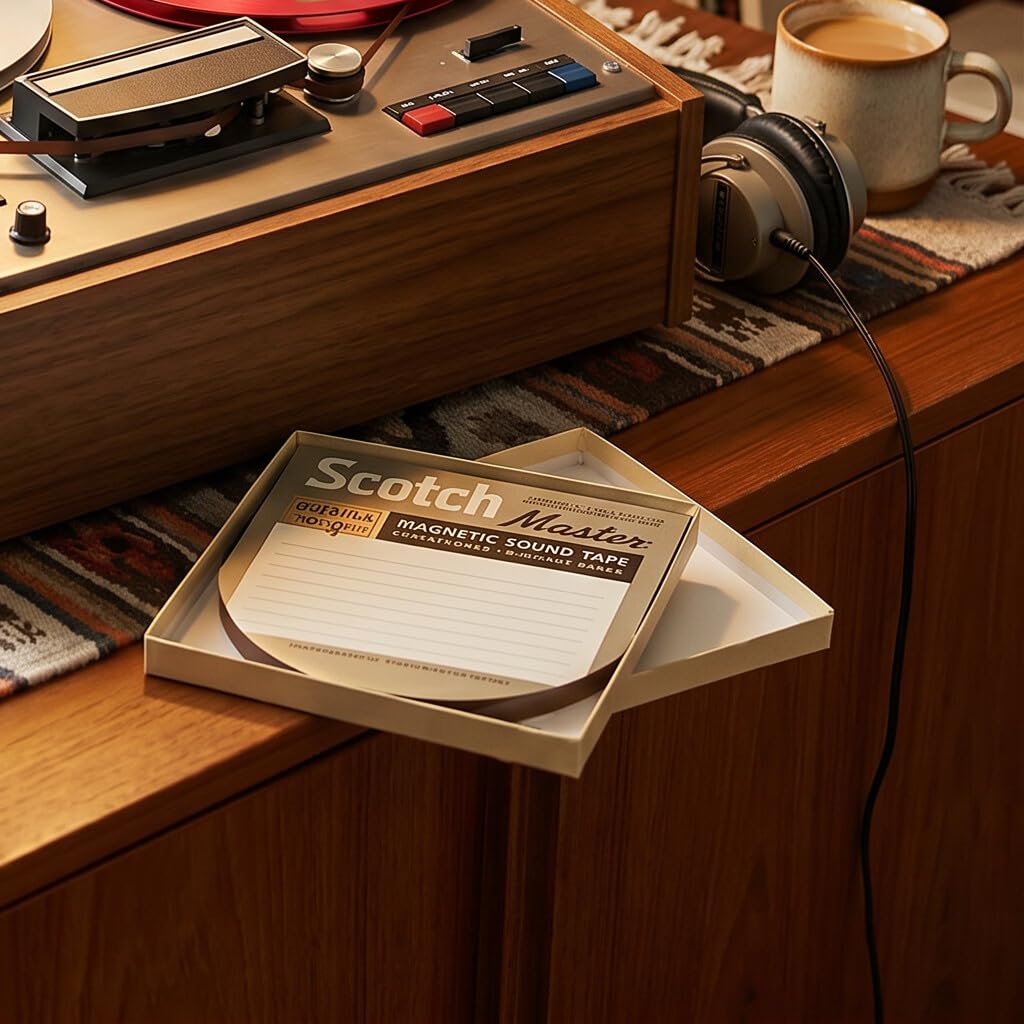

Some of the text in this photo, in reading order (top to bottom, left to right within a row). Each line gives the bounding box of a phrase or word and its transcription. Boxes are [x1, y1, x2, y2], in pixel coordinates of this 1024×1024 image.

[304, 457, 504, 519] Scotch
[396, 518, 500, 546] MAGNETIC
[504, 536, 575, 558] SOUND
[581, 549, 631, 568] TAPE
[497, 509, 653, 549] Master
